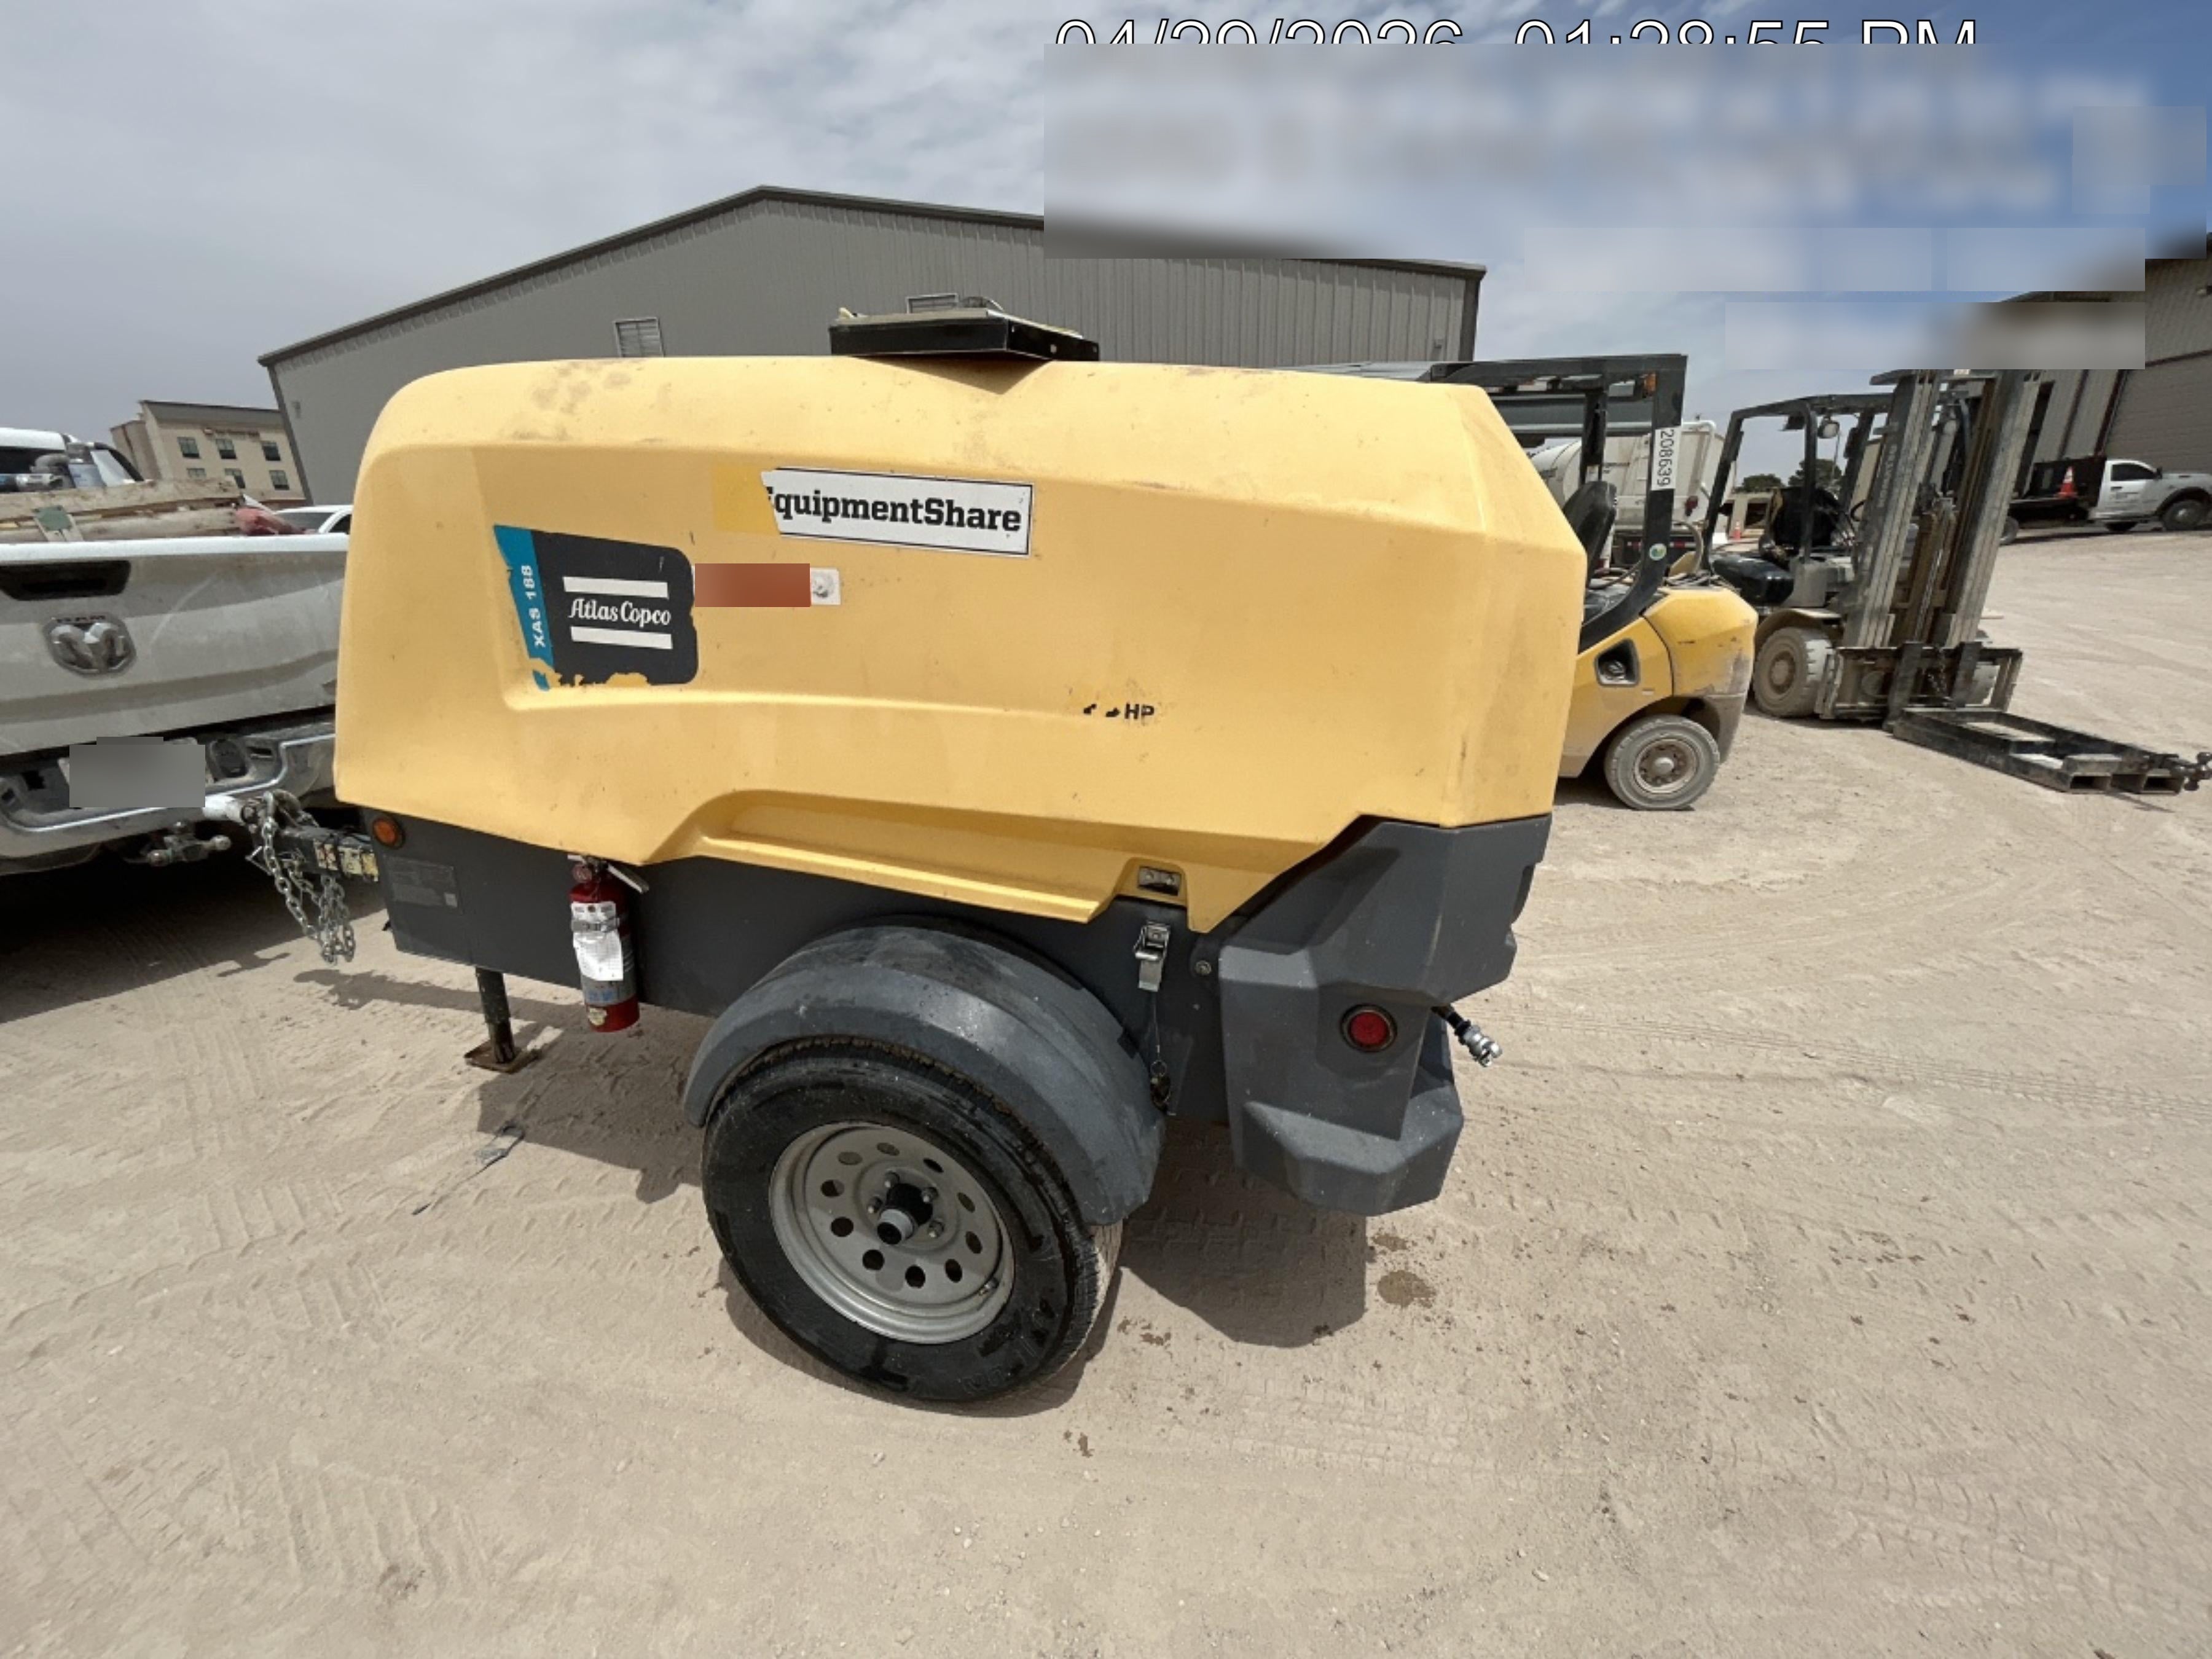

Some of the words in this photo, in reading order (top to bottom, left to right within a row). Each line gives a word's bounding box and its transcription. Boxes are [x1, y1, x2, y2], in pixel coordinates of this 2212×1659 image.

[1657, 429, 1674, 486] 208639
[528, 607, 546, 648] XAS
[568, 598, 619, 622] Atlas
[620, 600, 672, 629] Copco
[1124, 702, 1155, 721] HP
